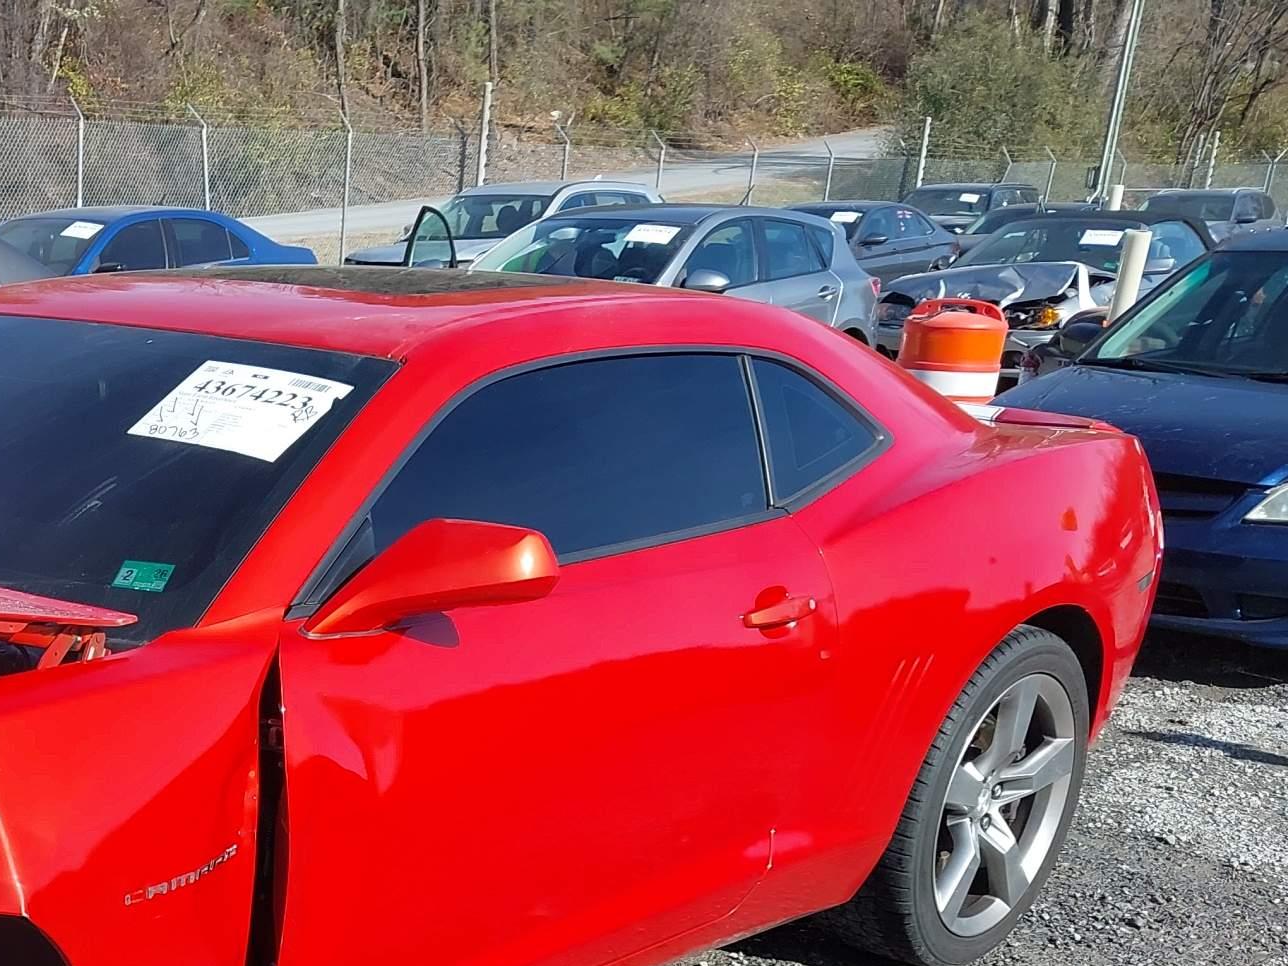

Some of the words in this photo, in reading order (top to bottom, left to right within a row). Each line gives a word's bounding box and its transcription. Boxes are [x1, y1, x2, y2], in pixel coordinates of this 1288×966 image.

[194, 379, 313, 409] 43674223
[148, 424, 199, 440] 80763
[122, 570, 135, 581] 2
